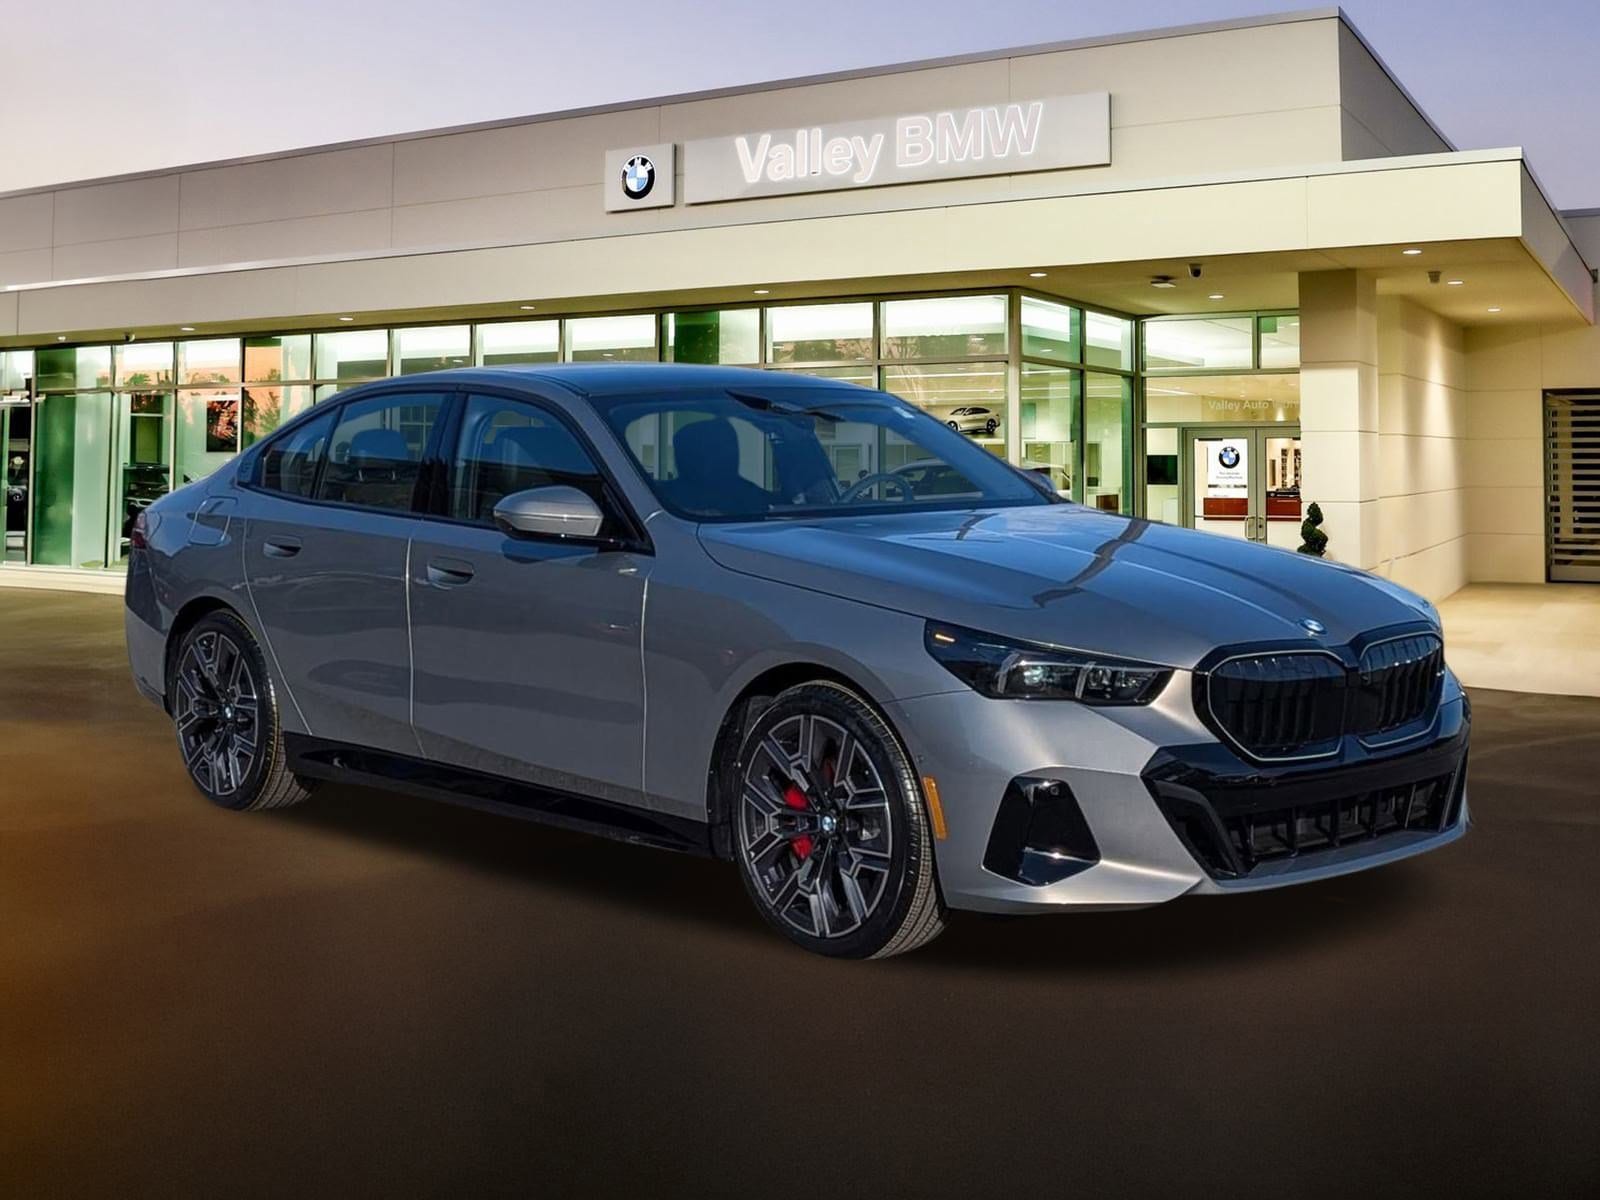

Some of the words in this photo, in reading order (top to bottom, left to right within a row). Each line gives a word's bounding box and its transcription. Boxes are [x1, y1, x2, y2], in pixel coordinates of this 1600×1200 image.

[734, 127, 885, 184] Valley
[896, 102, 1043, 167] BMW
[1208, 400, 1240, 412] Valley
[1242, 400, 1269, 409] Auto
